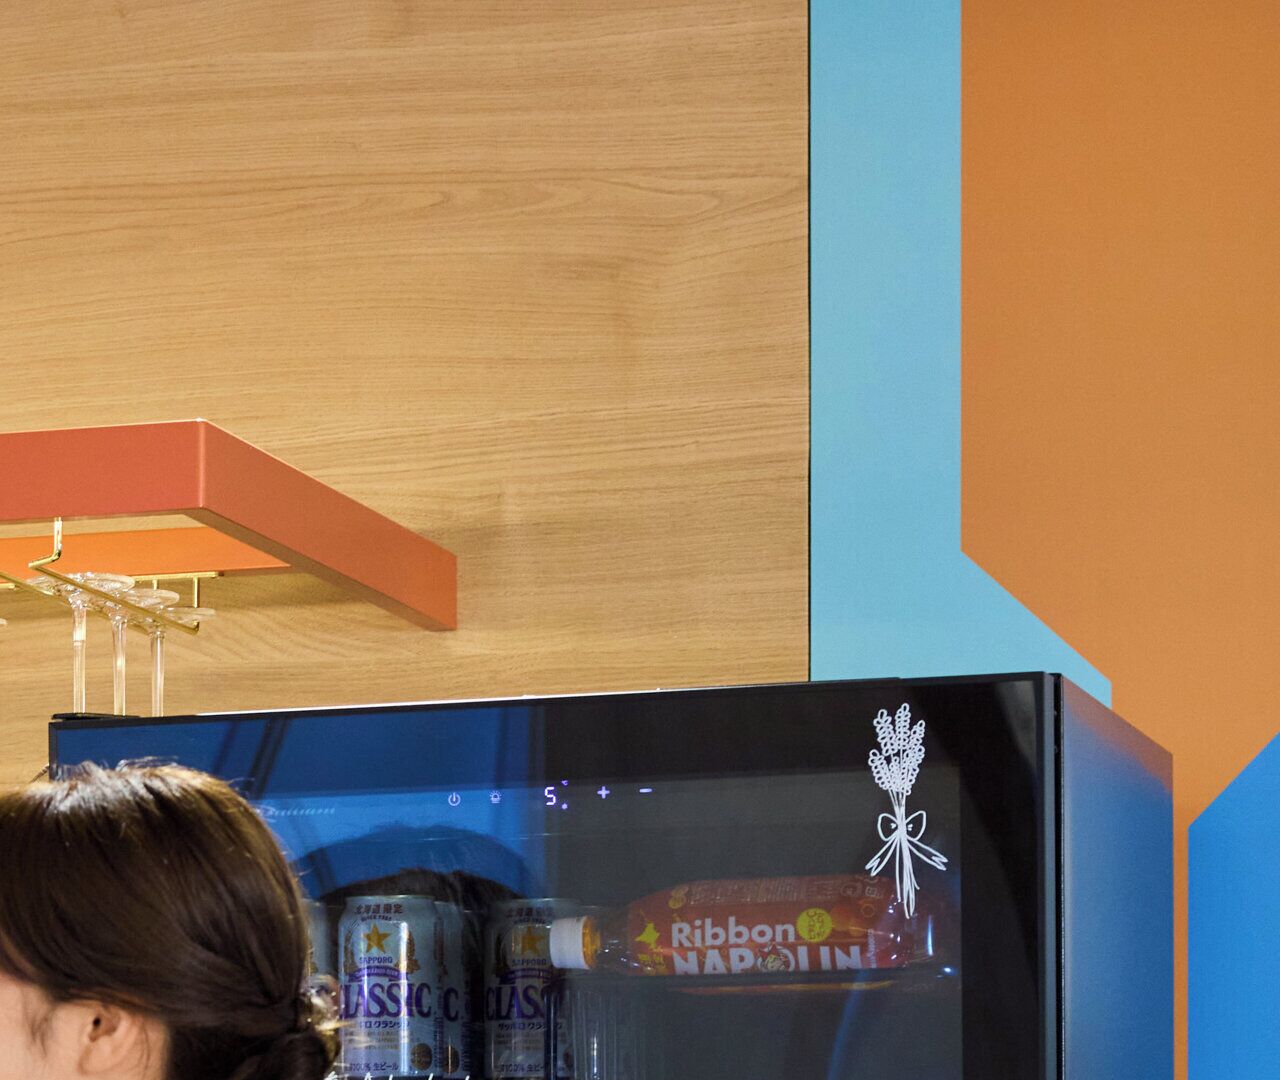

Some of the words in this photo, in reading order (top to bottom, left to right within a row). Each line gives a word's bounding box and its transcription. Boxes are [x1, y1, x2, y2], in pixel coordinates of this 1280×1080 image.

[671, 916, 795, 948] Ribbon
[359, 956, 393, 965] SAPPORO
[339, 982, 432, 1019] LASSIC
